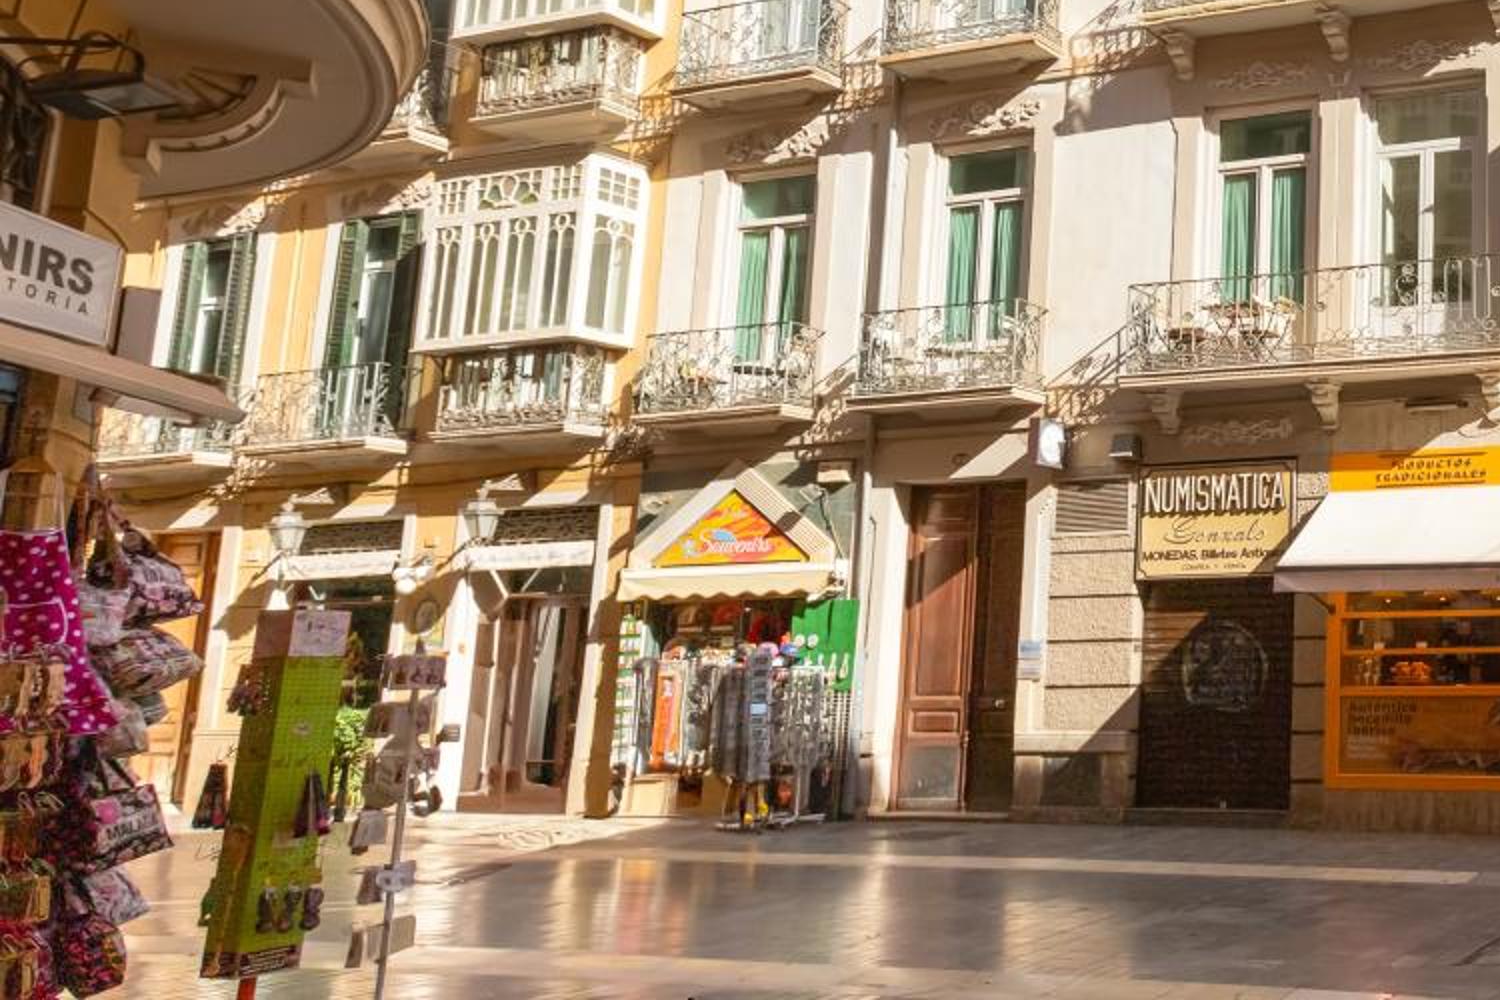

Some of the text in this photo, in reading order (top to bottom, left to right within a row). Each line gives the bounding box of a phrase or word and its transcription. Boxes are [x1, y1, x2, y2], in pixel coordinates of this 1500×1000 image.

[1392, 457, 1472, 470] PRODUCTOS
[1375, 468, 1487, 483] TRADICIONALES
[1144, 472, 1285, 513] NUMISMATICA
